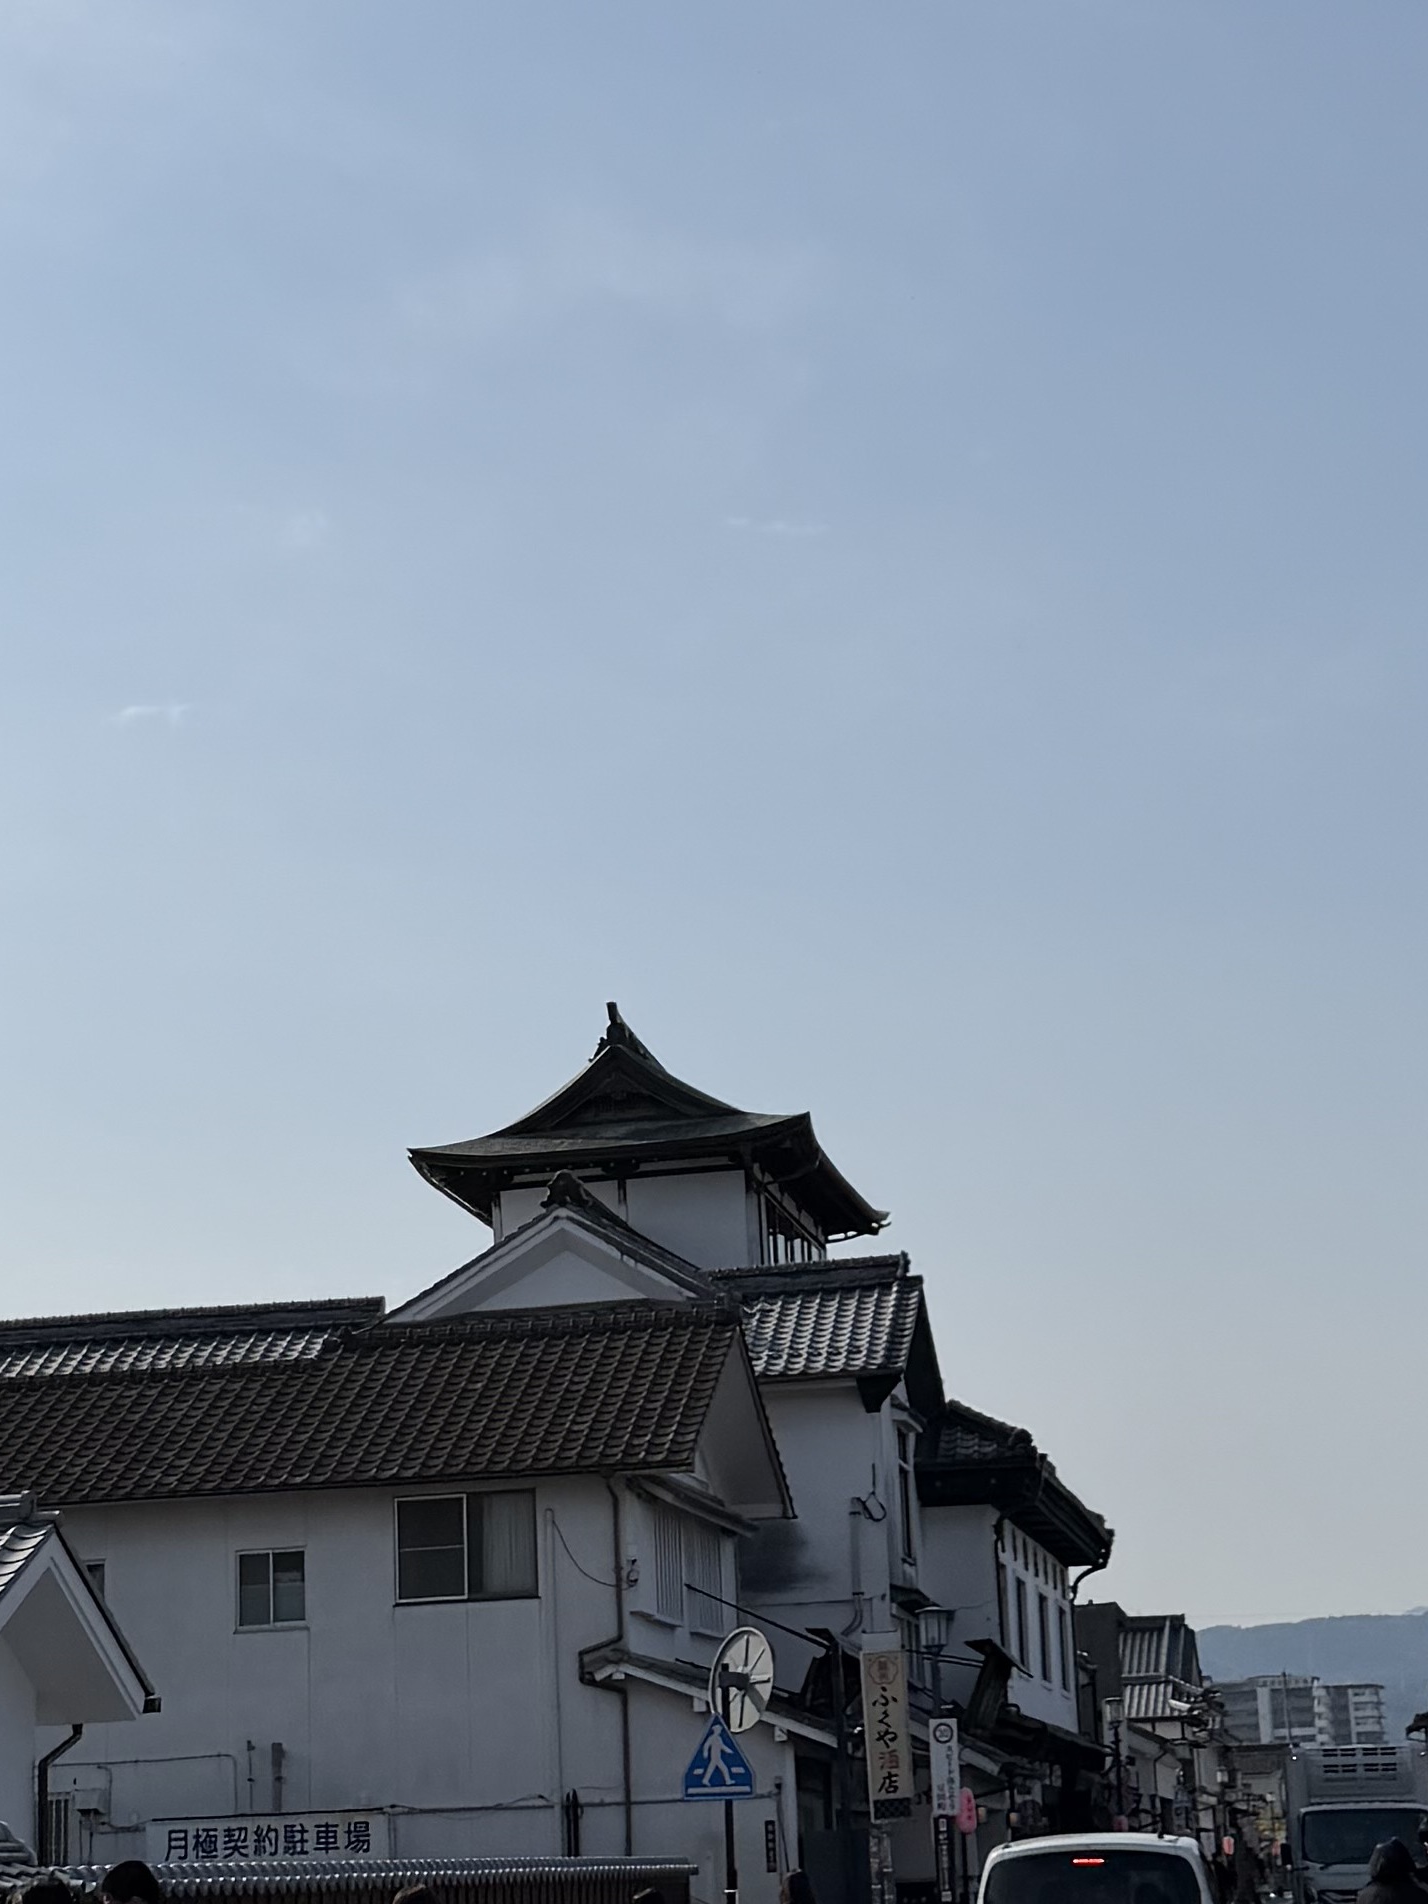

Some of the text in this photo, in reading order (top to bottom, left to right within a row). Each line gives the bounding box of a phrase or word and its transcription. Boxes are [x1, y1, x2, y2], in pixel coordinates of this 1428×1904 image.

[872, 1685, 900, 1795] ふくや酒店
[165, 1819, 372, 1861] 月極契約駐車場
